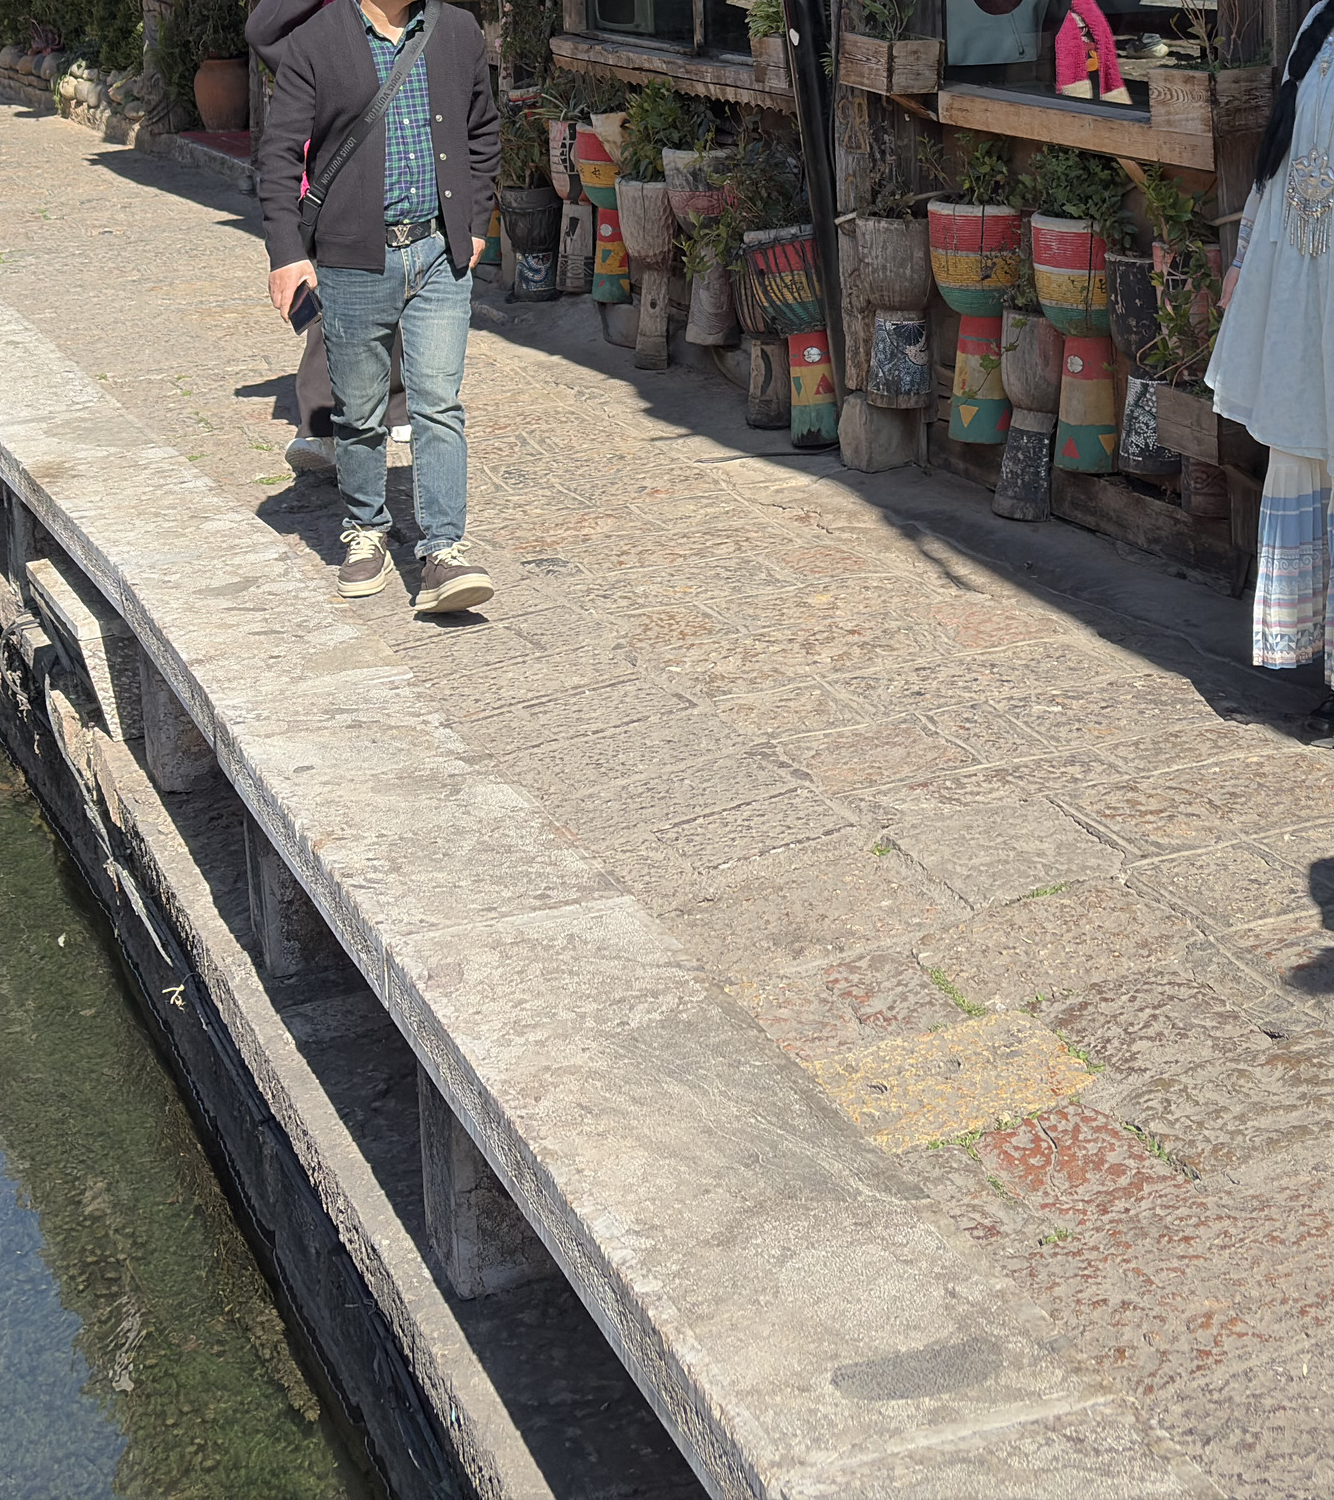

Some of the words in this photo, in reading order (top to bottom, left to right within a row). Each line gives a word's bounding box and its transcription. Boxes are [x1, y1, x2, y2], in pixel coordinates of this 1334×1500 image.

[388, 70, 403, 93] LOUIS
[364, 91, 391, 124] VUITTON
[340, 136, 357, 158] LOUIS
[320, 156, 343, 186] VUITTON
